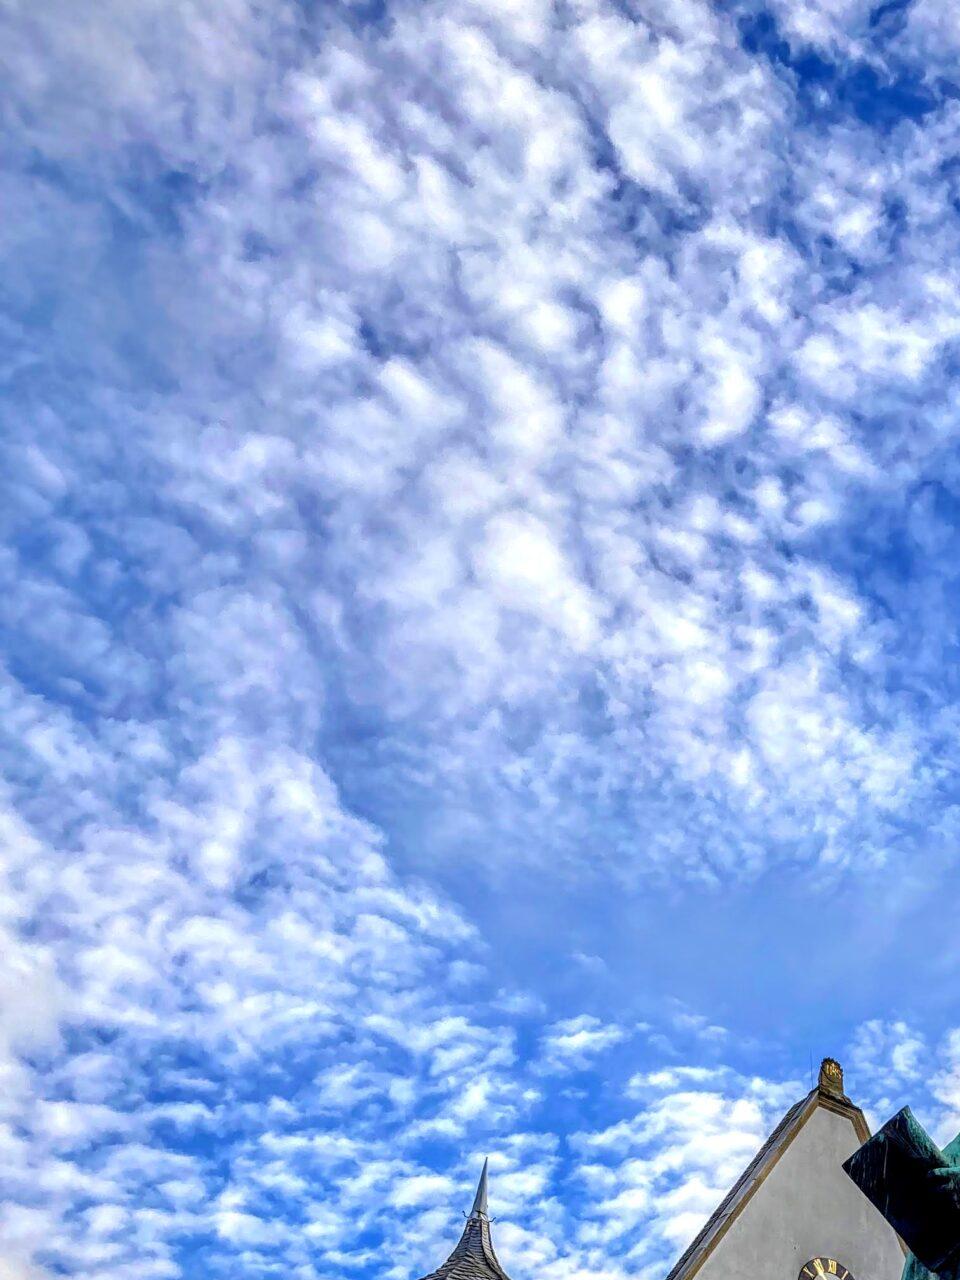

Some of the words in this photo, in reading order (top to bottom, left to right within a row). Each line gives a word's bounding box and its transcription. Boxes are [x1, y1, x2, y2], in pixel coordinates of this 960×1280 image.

[803, 1266, 815, 1279] X
[828, 1259, 837, 1274] XII
[841, 1270, 849, 1280] I
